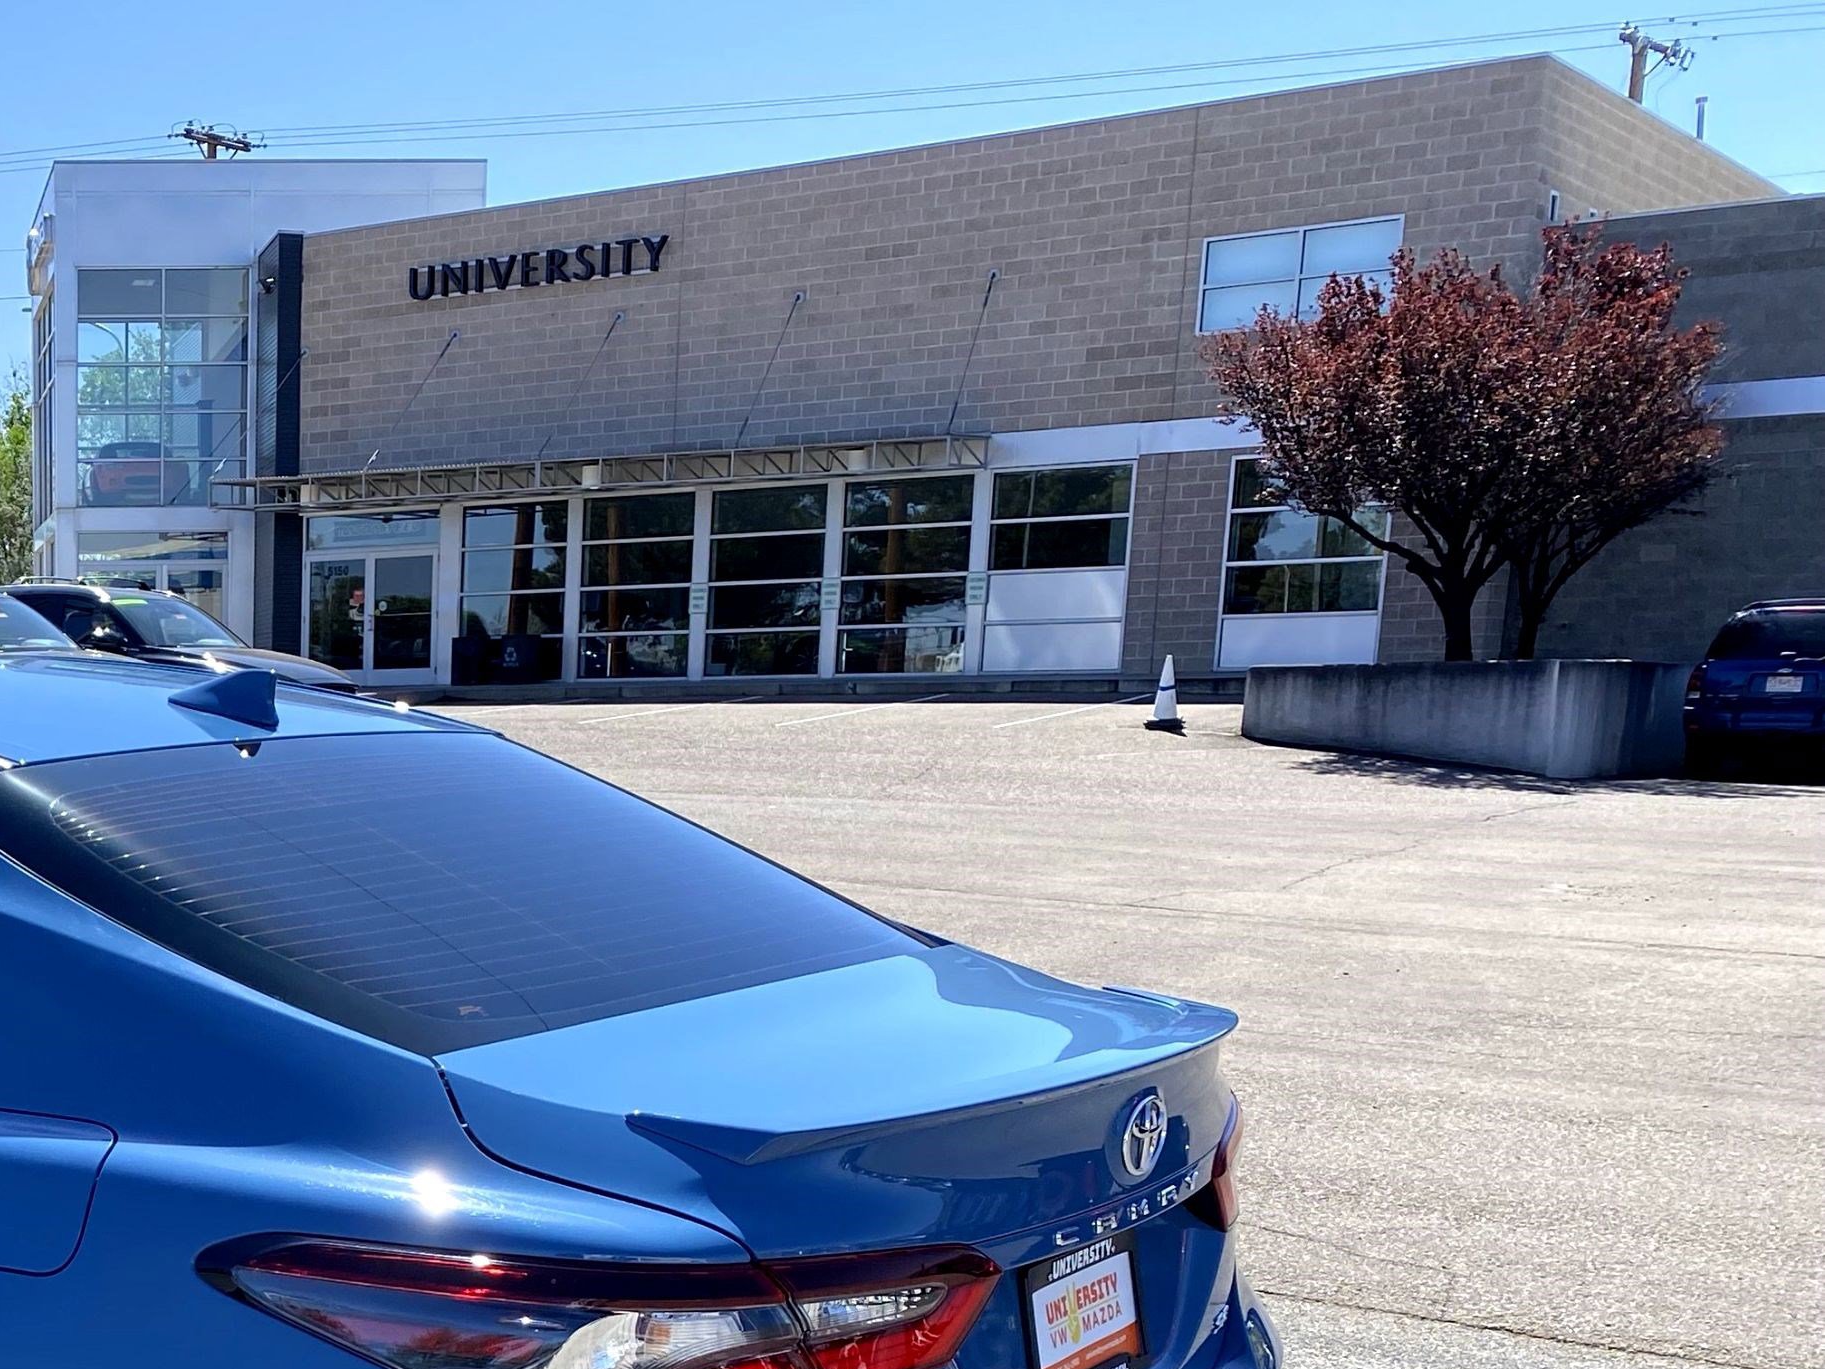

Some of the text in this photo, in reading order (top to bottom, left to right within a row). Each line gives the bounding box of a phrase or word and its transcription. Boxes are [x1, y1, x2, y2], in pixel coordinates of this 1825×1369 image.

[409, 235, 670, 300] UNIVERSITY
[1054, 1170, 1198, 1246] CAMRY
[1050, 1327, 1068, 1349] VW
[1082, 1300, 1123, 1332] MAZDA
